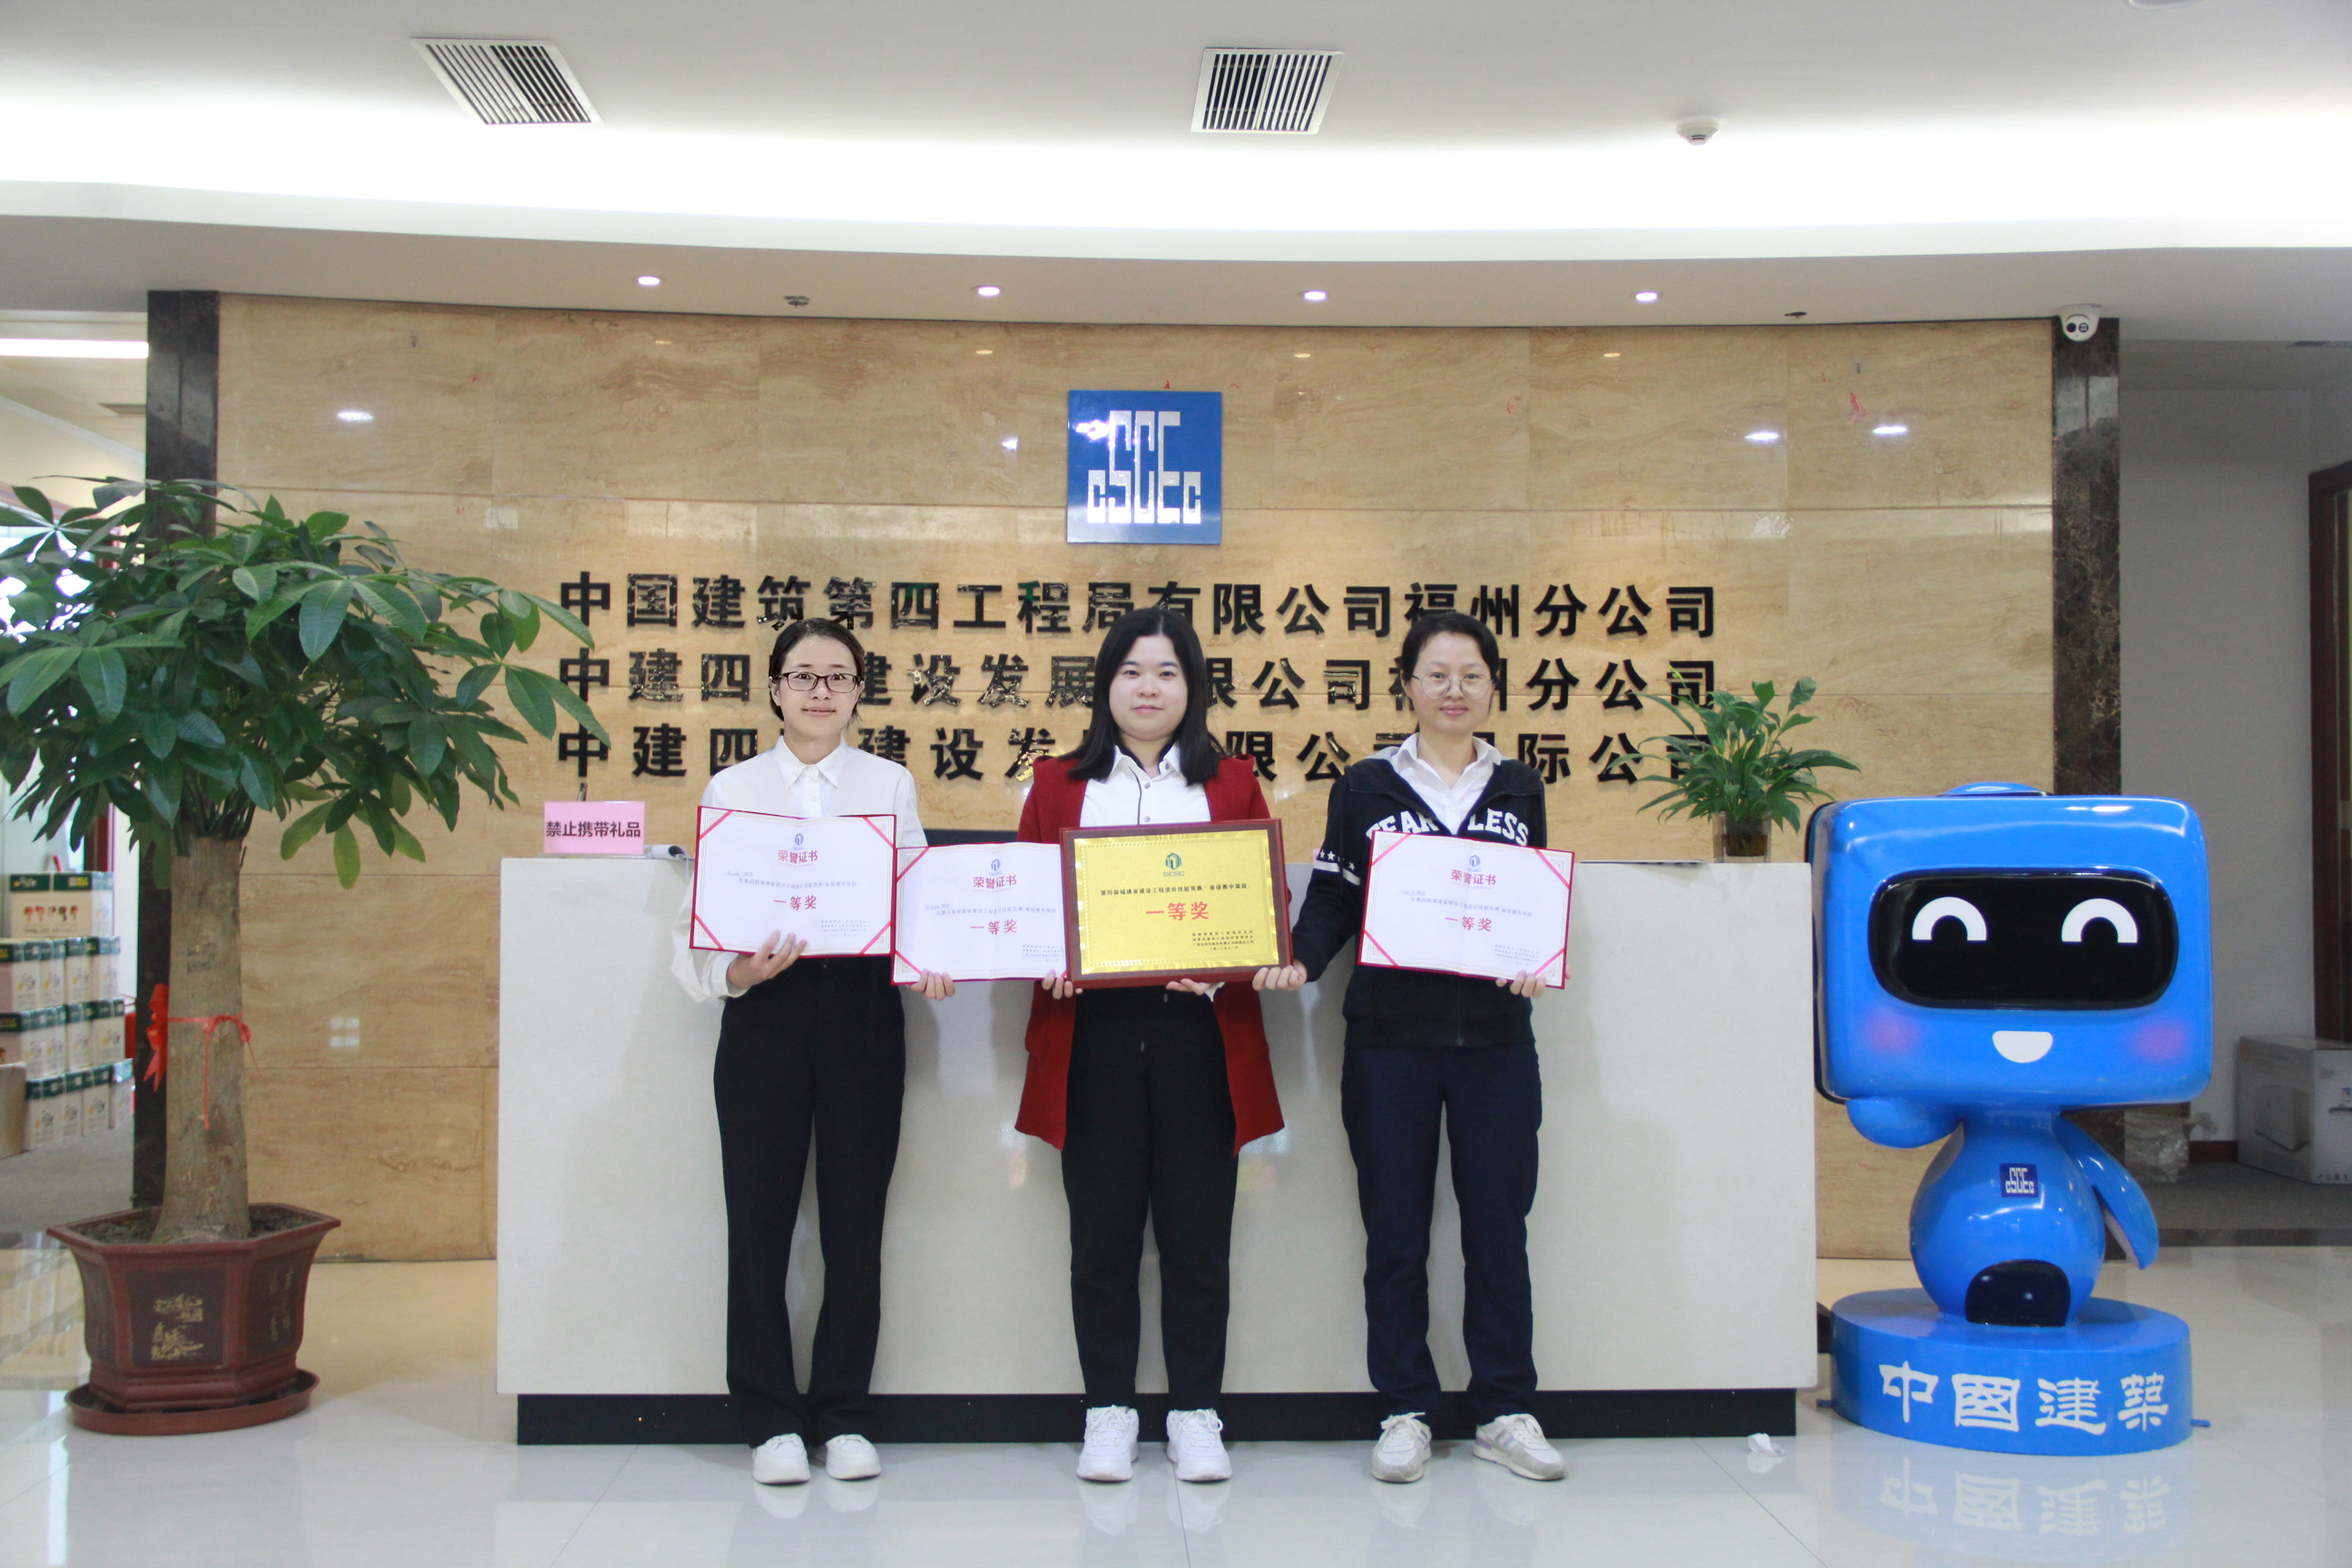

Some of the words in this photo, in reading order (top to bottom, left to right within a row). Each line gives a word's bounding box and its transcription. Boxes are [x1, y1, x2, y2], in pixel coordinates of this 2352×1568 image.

[560, 571, 1714, 638] 中国建筑第四工程局有限公司福州分公司
[559, 646, 1714, 711] 中建四建设发展限公司分公司
[545, 820, 641, 838] 禁止携带礼品
[778, 849, 818, 863] 荣誉证书
[973, 874, 1017, 889] 荣誉证书
[1451, 869, 1496, 886] 荣誉证书
[773, 895, 818, 910] 一等奖
[1145, 901, 1209, 921] 一等奖
[970, 918, 1017, 935] 一等奖
[1445, 916, 1493, 932] 一等奖
[1878, 1360, 2170, 1436] 中國建築
